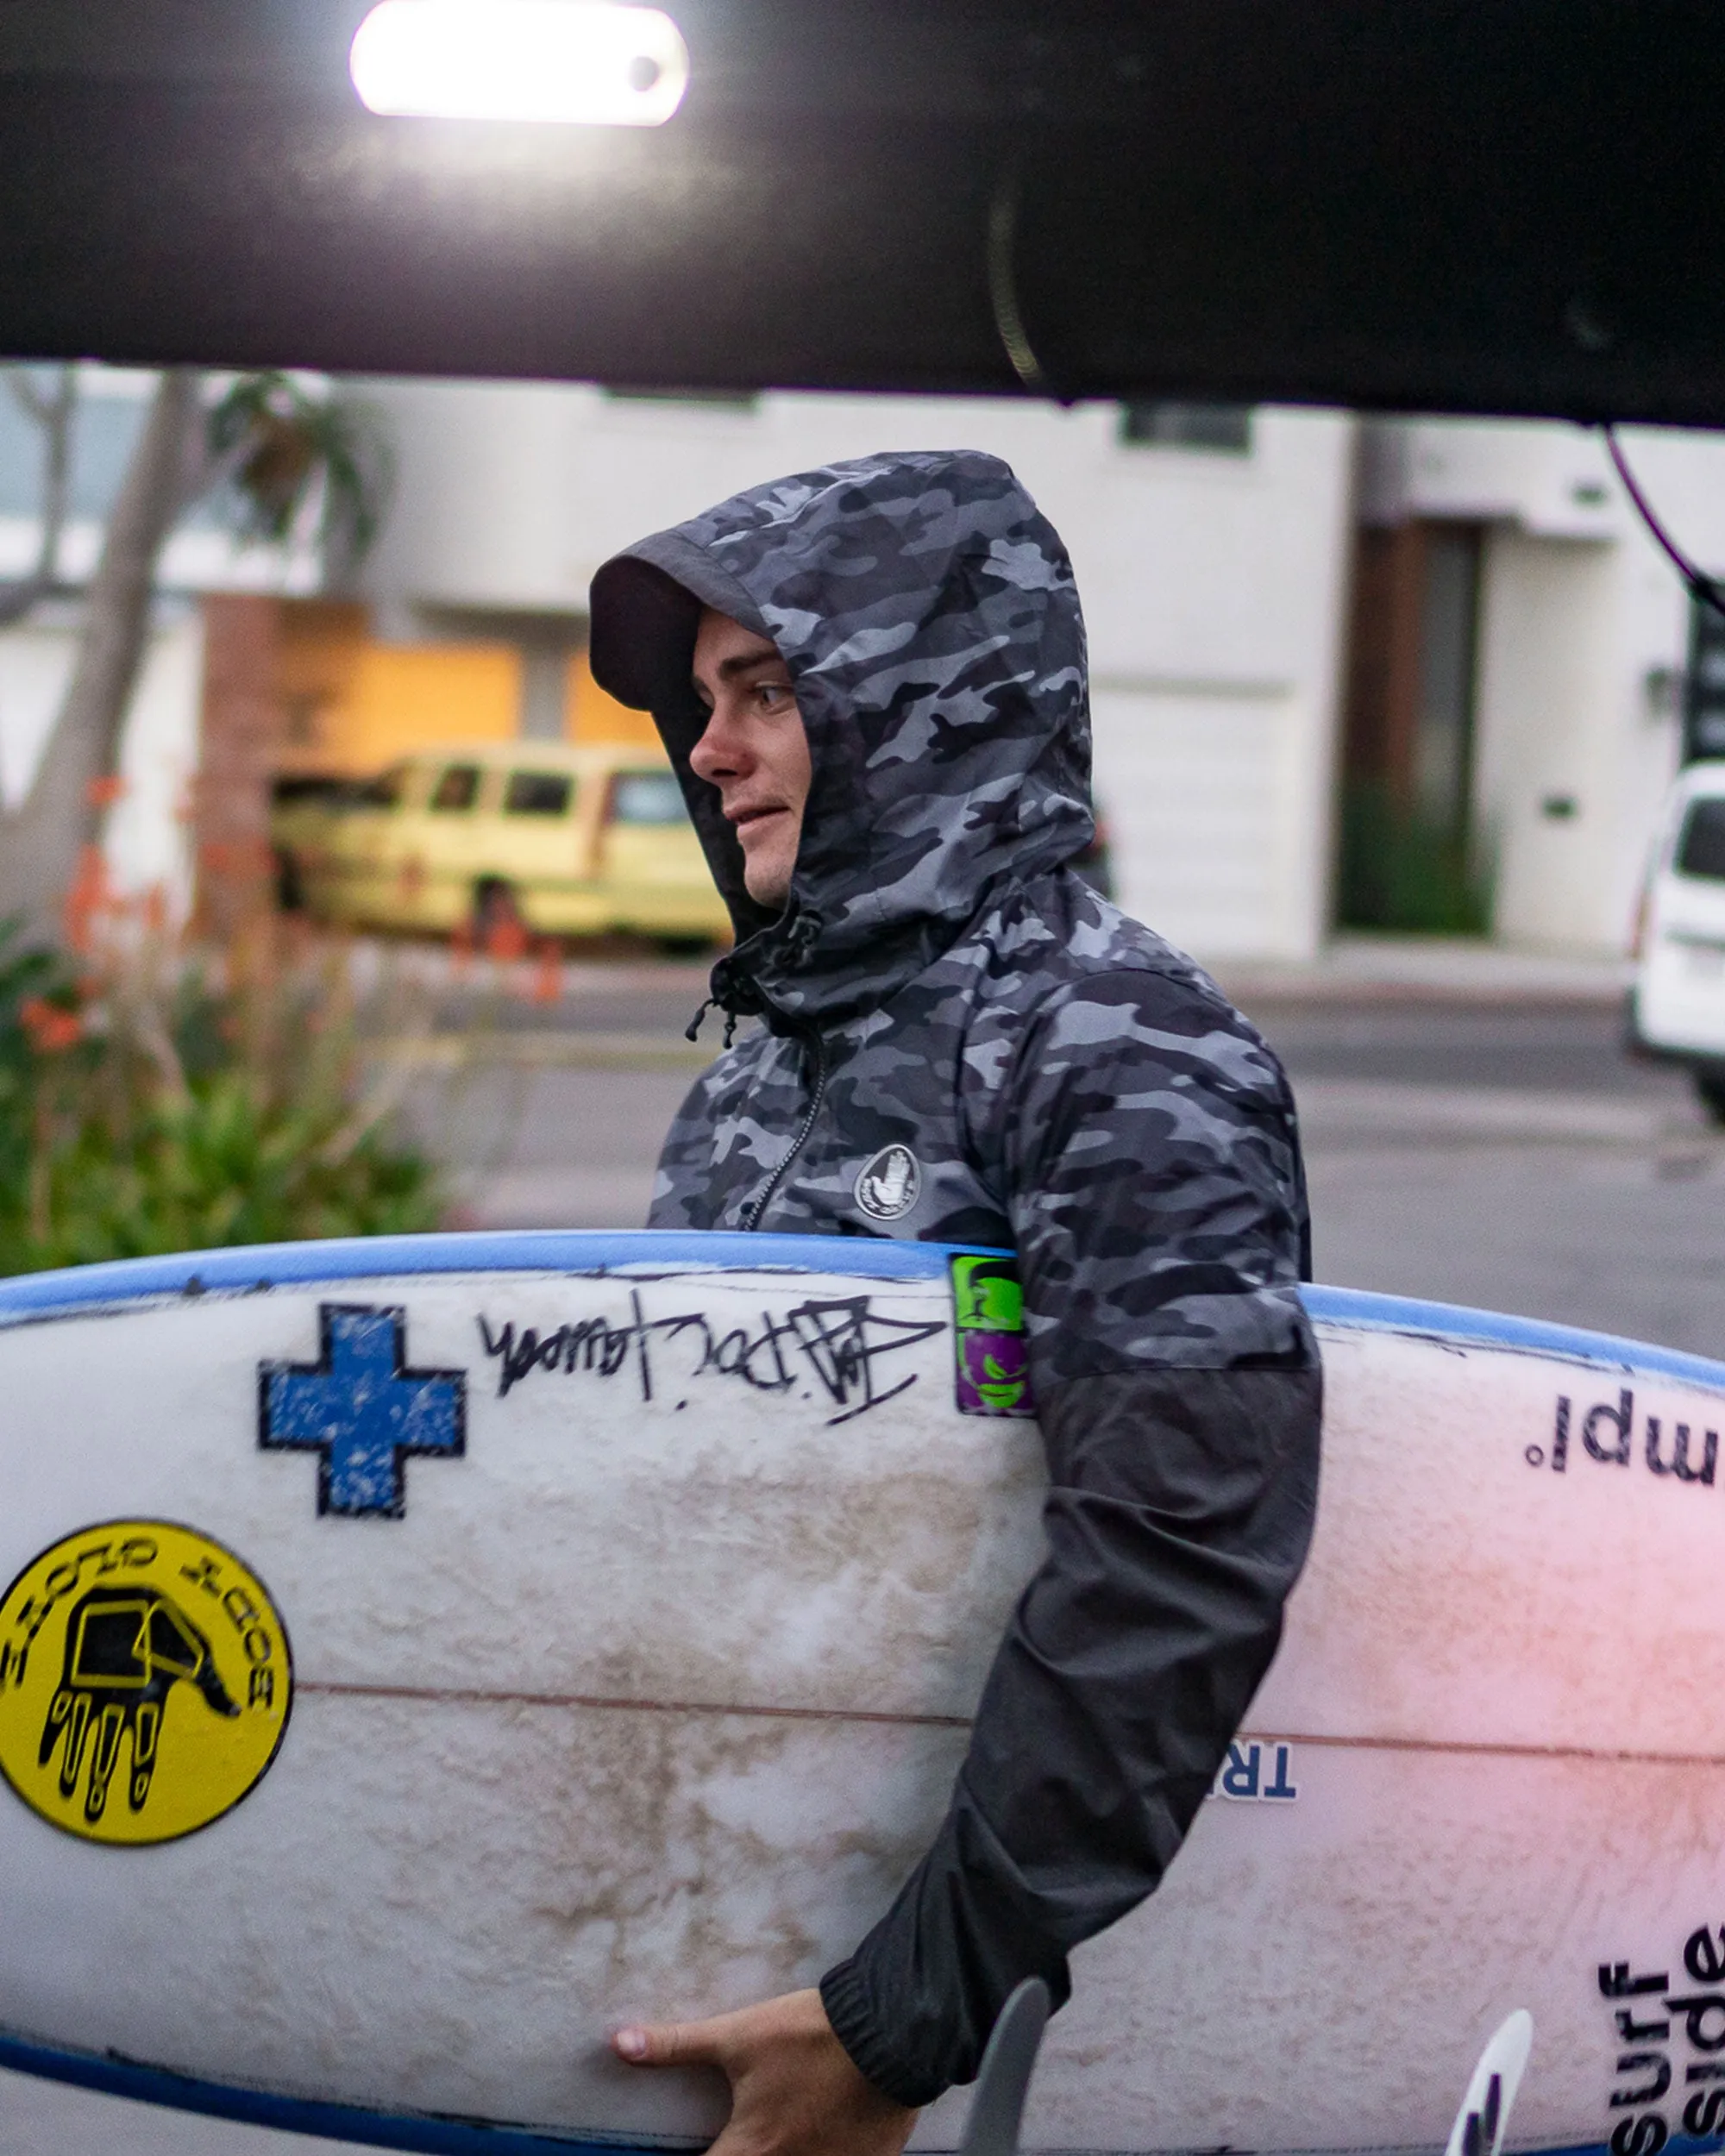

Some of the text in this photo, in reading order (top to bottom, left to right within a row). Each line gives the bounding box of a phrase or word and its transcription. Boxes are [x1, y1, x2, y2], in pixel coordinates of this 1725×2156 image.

[179, 1555, 274, 1709] BODY
[1208, 1743, 1296, 1798] TR
[1597, 1962, 1672, 2156] surf
